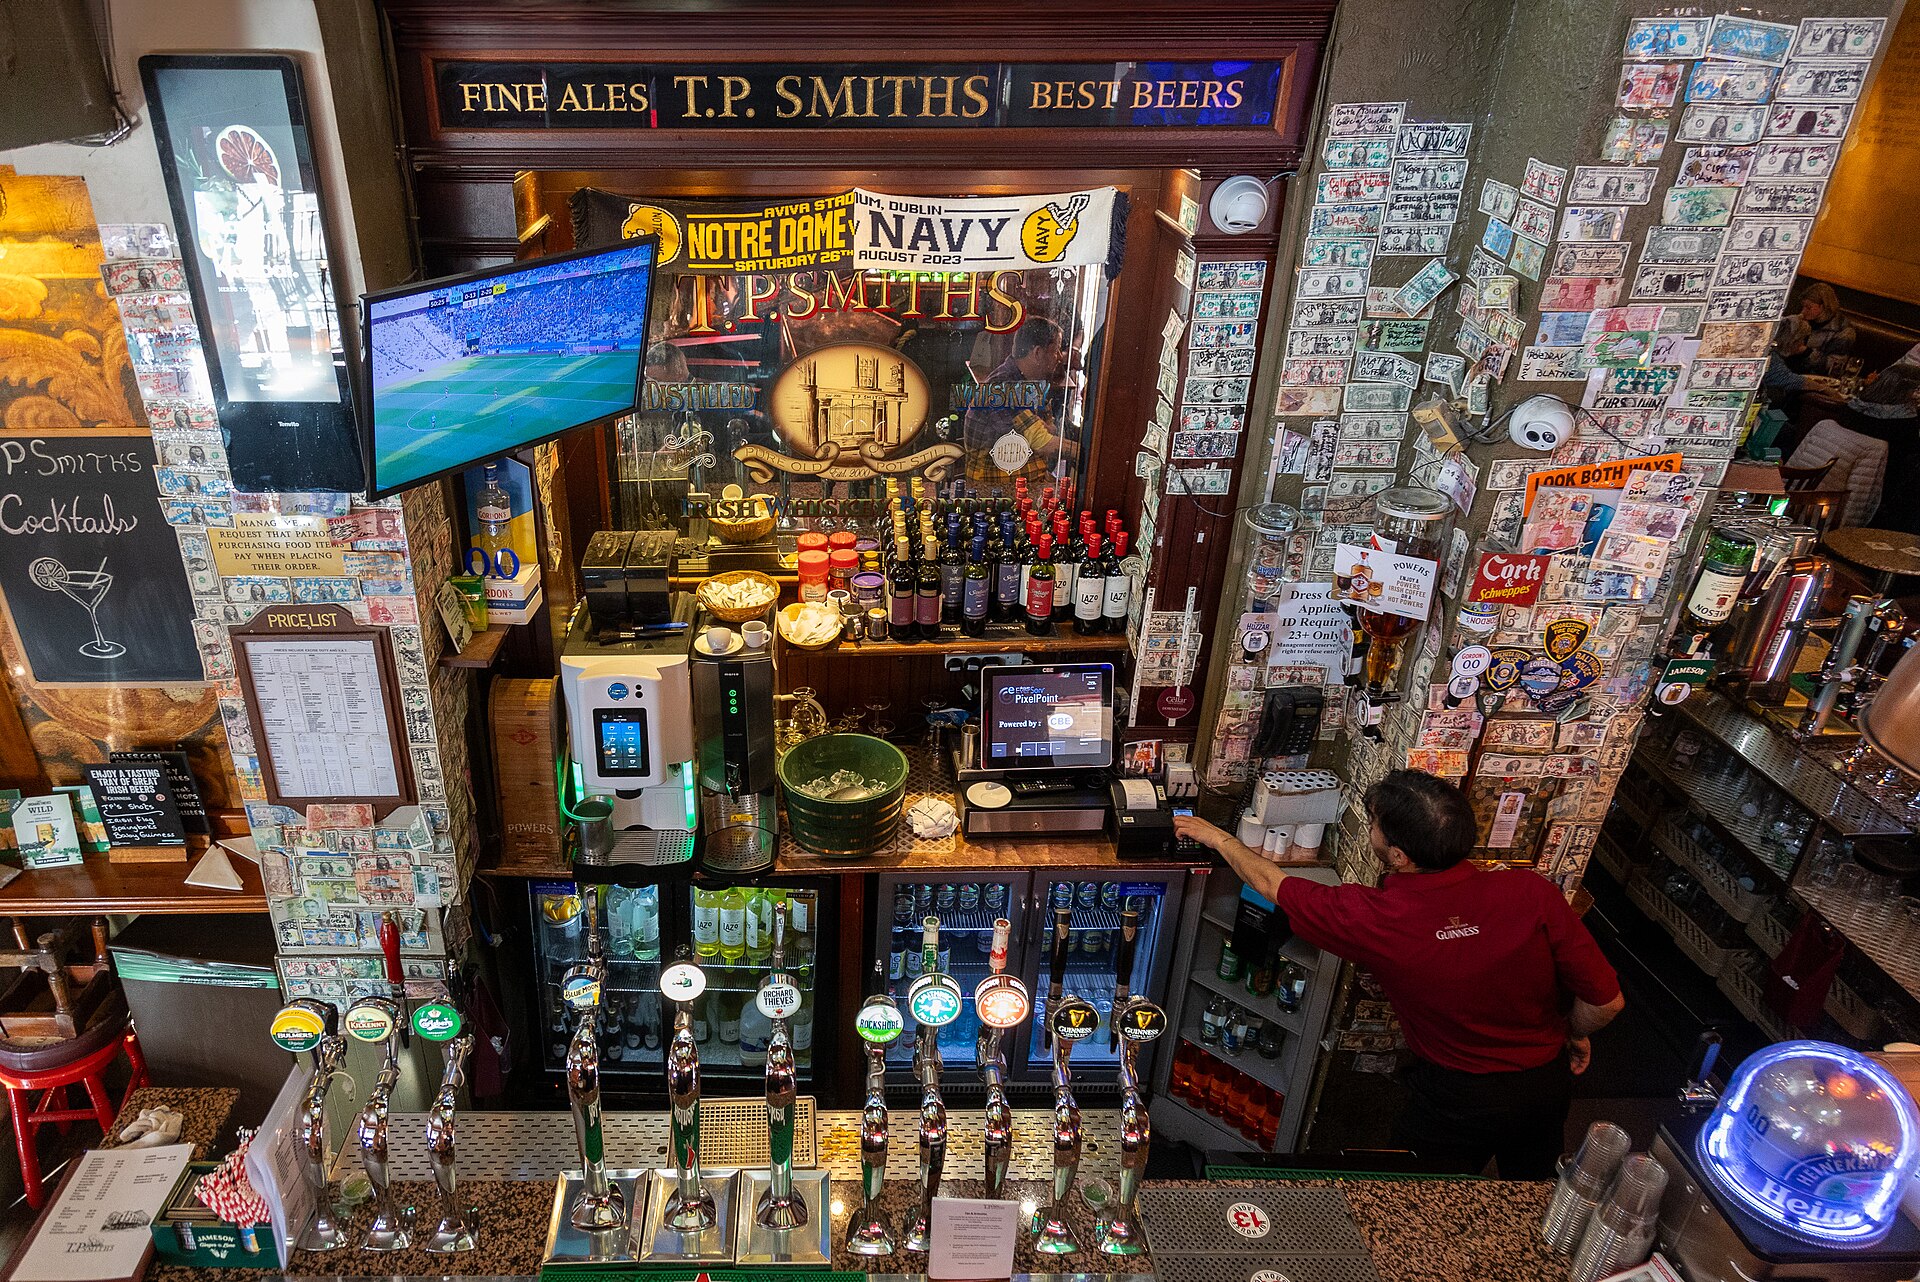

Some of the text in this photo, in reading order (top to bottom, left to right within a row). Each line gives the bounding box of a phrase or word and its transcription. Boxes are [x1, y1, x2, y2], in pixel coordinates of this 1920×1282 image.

[459, 75, 1244, 118] FINE ALES T.P. SMITHS BEST BEERS
[764, 203, 810, 219] AVIVA
[889, 201, 942, 215] DUBLIN
[688, 221, 773, 259] NOTRE
[779, 208, 847, 251] DAME
[868, 211, 1011, 252] NAVY
[1034, 215, 1052, 256] NAVY
[735, 249, 962, 272] SATURDAY 26TH AUGUST 2023
[1614, 367, 1679, 380] KANSAS
[1615, 380, 1668, 396] CITY
[647, 382, 1051, 411] DISTILLED WHISKEY
[997, 443, 1028, 463] BEERS
[745, 447, 952, 472] PURE OLD POT STILL
[849, 469, 871, 478] 2000
[1536, 470, 1576, 491] LOOK
[1581, 464, 1622, 485] BOTH
[681, 498, 758, 519] IRISH
[764, 497, 892, 519] WHISKEY
[0, 493, 139, 536] Cocktails
[219, 530, 291, 538] REQUEST THAT
[218, 541, 281, 549] PURCHASING
[285, 562, 321, 570] ORDER.
[1393, 562, 1430, 577] POWERS
[1483, 555, 1541, 581] Cork
[1396, 581, 1420, 590] POWERS
[1505, 577, 1514, 587] &
[484, 588, 513, 599] RDON'S
[1289, 590, 1323, 600] Dress
[1389, 585, 1426, 598] IRISH COFFEE
[1478, 584, 1532, 600] Schweppes
[1400, 599, 1424, 608] POWERS
[1298, 604, 1342, 615] Applies
[267, 613, 338, 628] PRICE LIST
[1282, 618, 1297, 626] ID
[1246, 623, 1270, 631] HUZZAR
[1288, 630, 1339, 642] 23+ Only
[1574, 661, 1591, 677] POLICE
[1668, 667, 1706, 676] JAMESON
[1526, 686, 1549, 695] POLICE
[1015, 694, 1059, 703] PixelPoint
[1165, 695, 1187, 704] Cellar
[999, 717, 1071, 728] Powered by CBE
[90, 769, 161, 778] ENJOY A TASTING
[97, 777, 158, 786] TRAY OF GREAT
[106, 786, 129, 794] IRISH
[28, 806, 54, 814] WILD
[507, 823, 554, 835] POWERS
[113, 832, 140, 840] Baby
[1436, 925, 1480, 940] GUINNESS
[564, 983, 600, 999] BLUE MOON
[763, 988, 794, 998] ORCHARD
[764, 996, 794, 1005] THIEVES
[918, 1013, 950, 1023] PALE ALE
[1003, 1016, 1017, 1024] ALE
[860, 1019, 899, 1030] ROCKSHORE
[1058, 1025, 1092, 1034] GUINNESS
[1124, 1026, 1159, 1035] GUINNESS
[1797, 1153, 1879, 1186] HEINEKEN
[1233, 1211, 1262, 1228] 13
[197, 1234, 235, 1243] JAMESON
